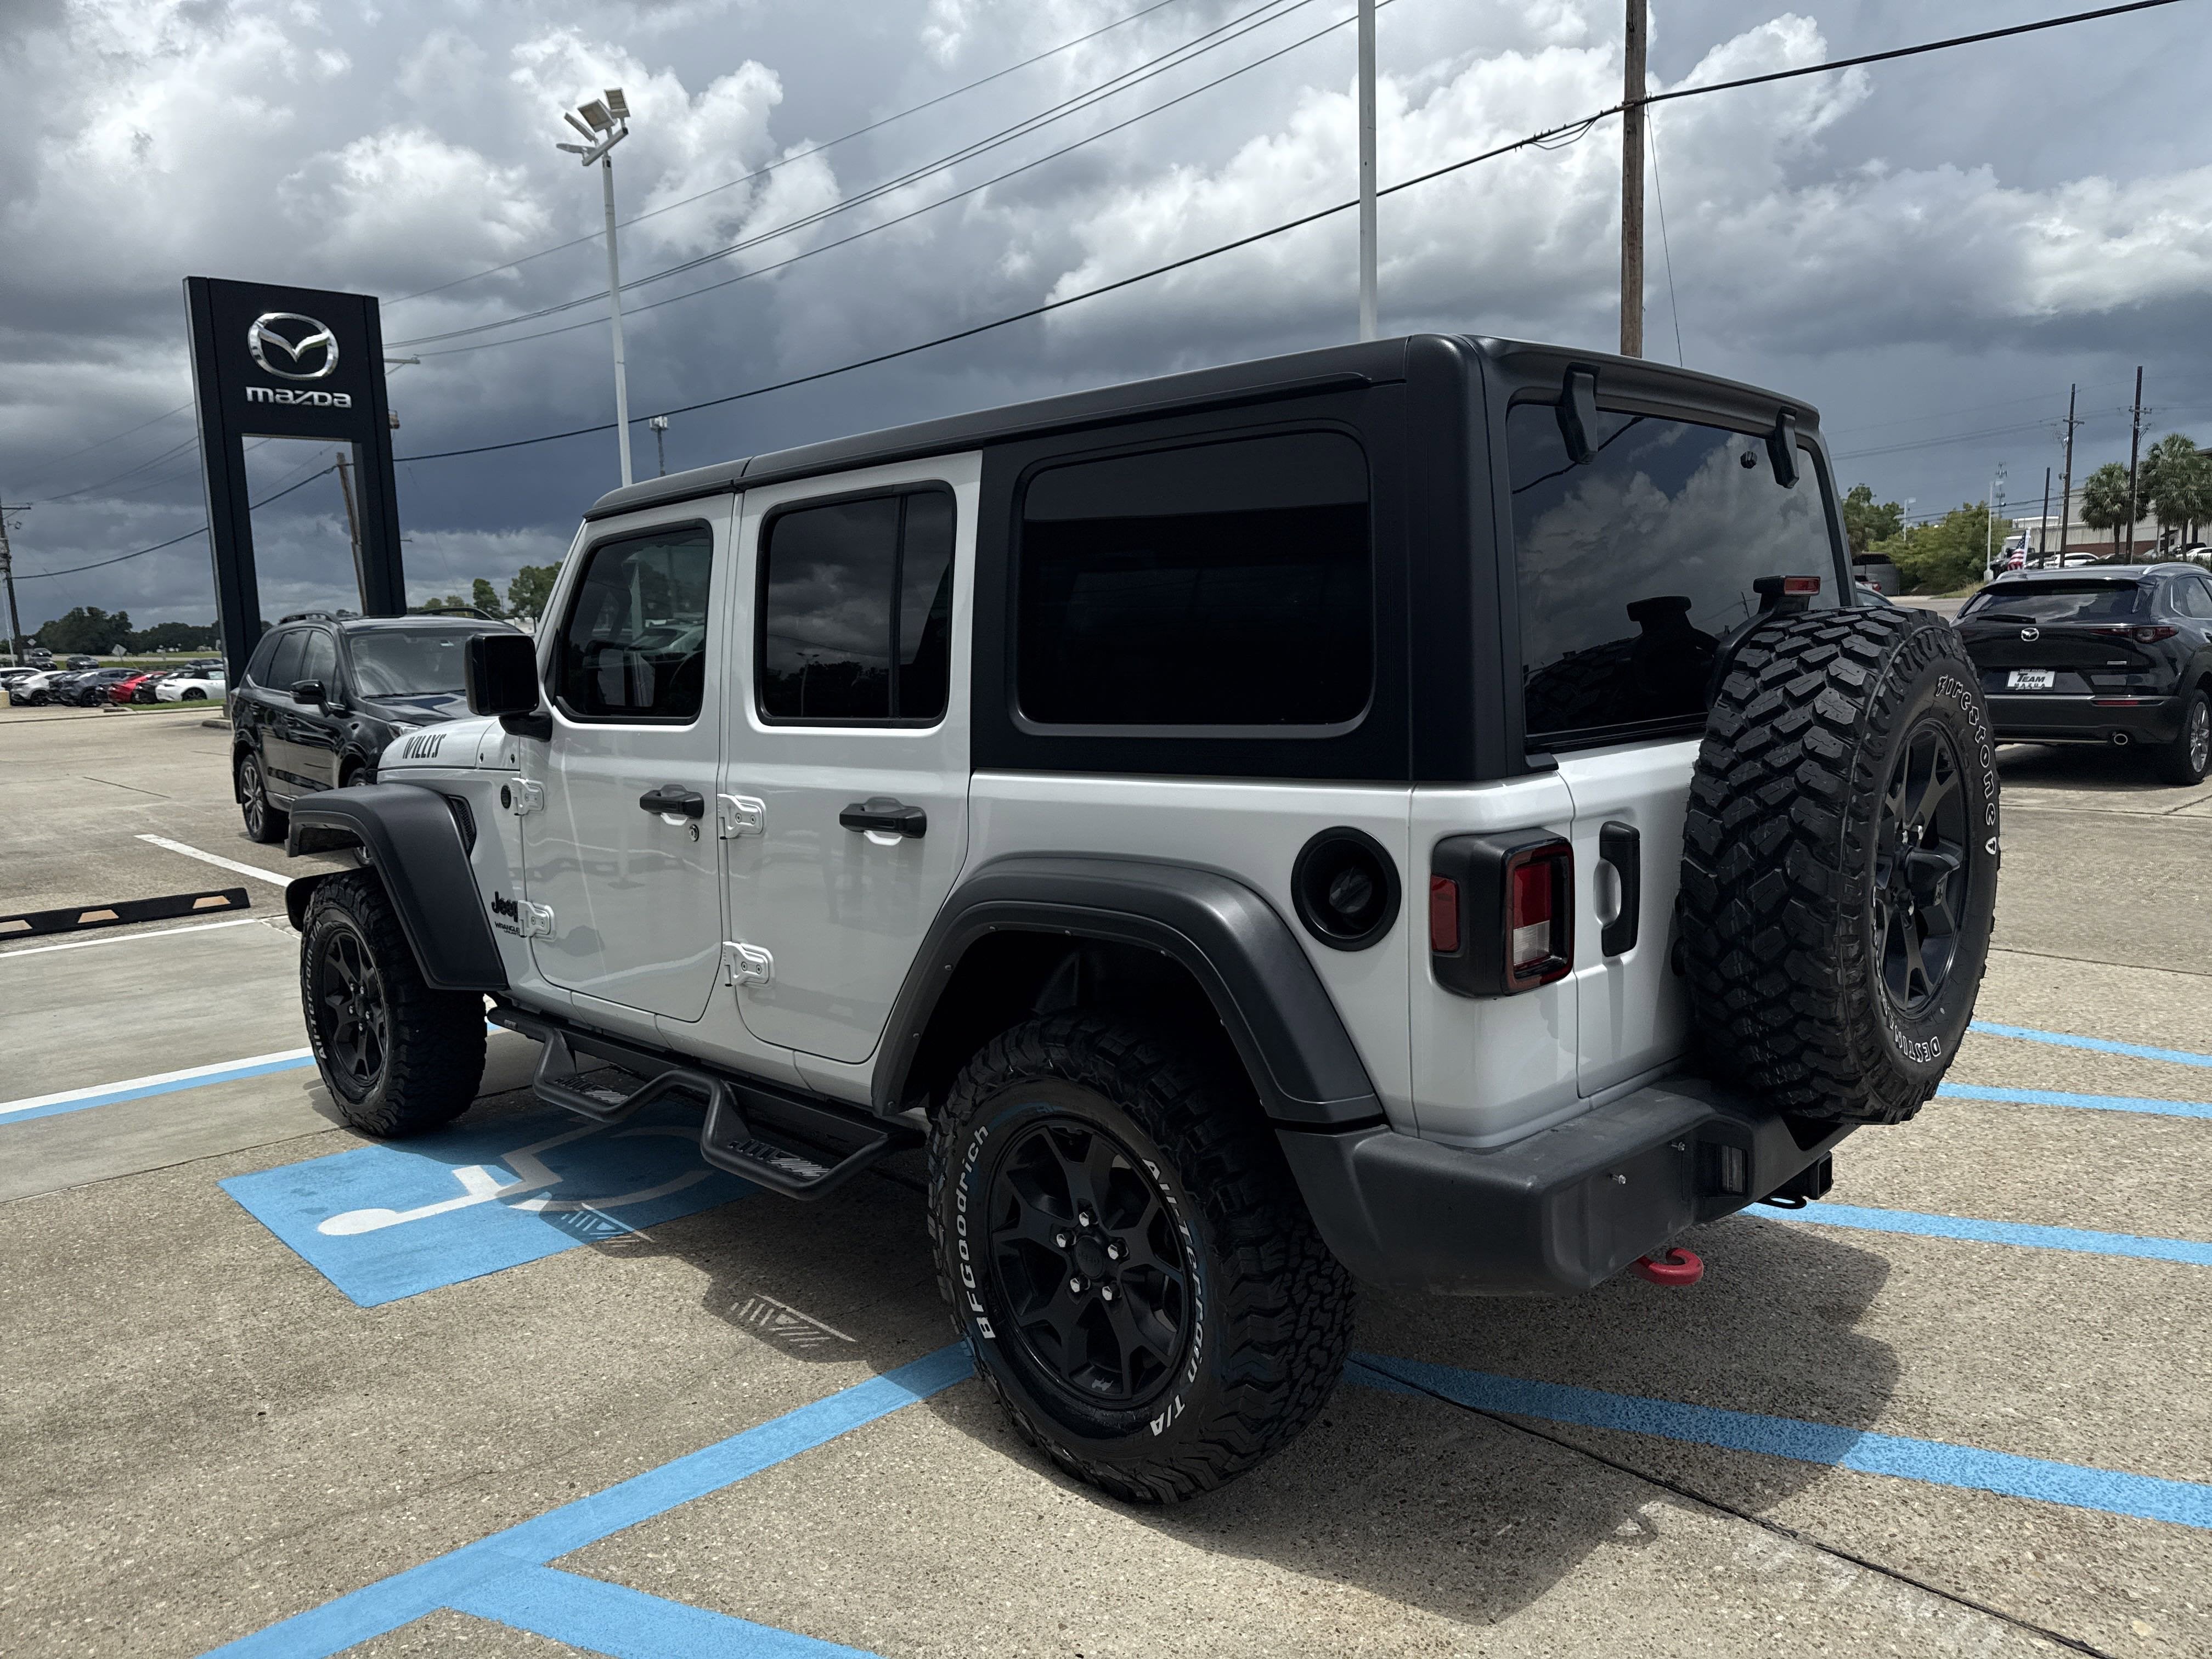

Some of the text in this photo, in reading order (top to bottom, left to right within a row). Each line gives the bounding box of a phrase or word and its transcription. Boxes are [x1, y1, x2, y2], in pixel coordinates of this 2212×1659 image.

[2017, 673, 2046, 682] TEAM
[402, 733, 447, 759] WILLYS
[494, 921, 521, 934] WRANGLE
[954, 1125, 996, 1340] BFGoodrich
[1142, 1159, 1204, 1436] All-Terrain T/A
